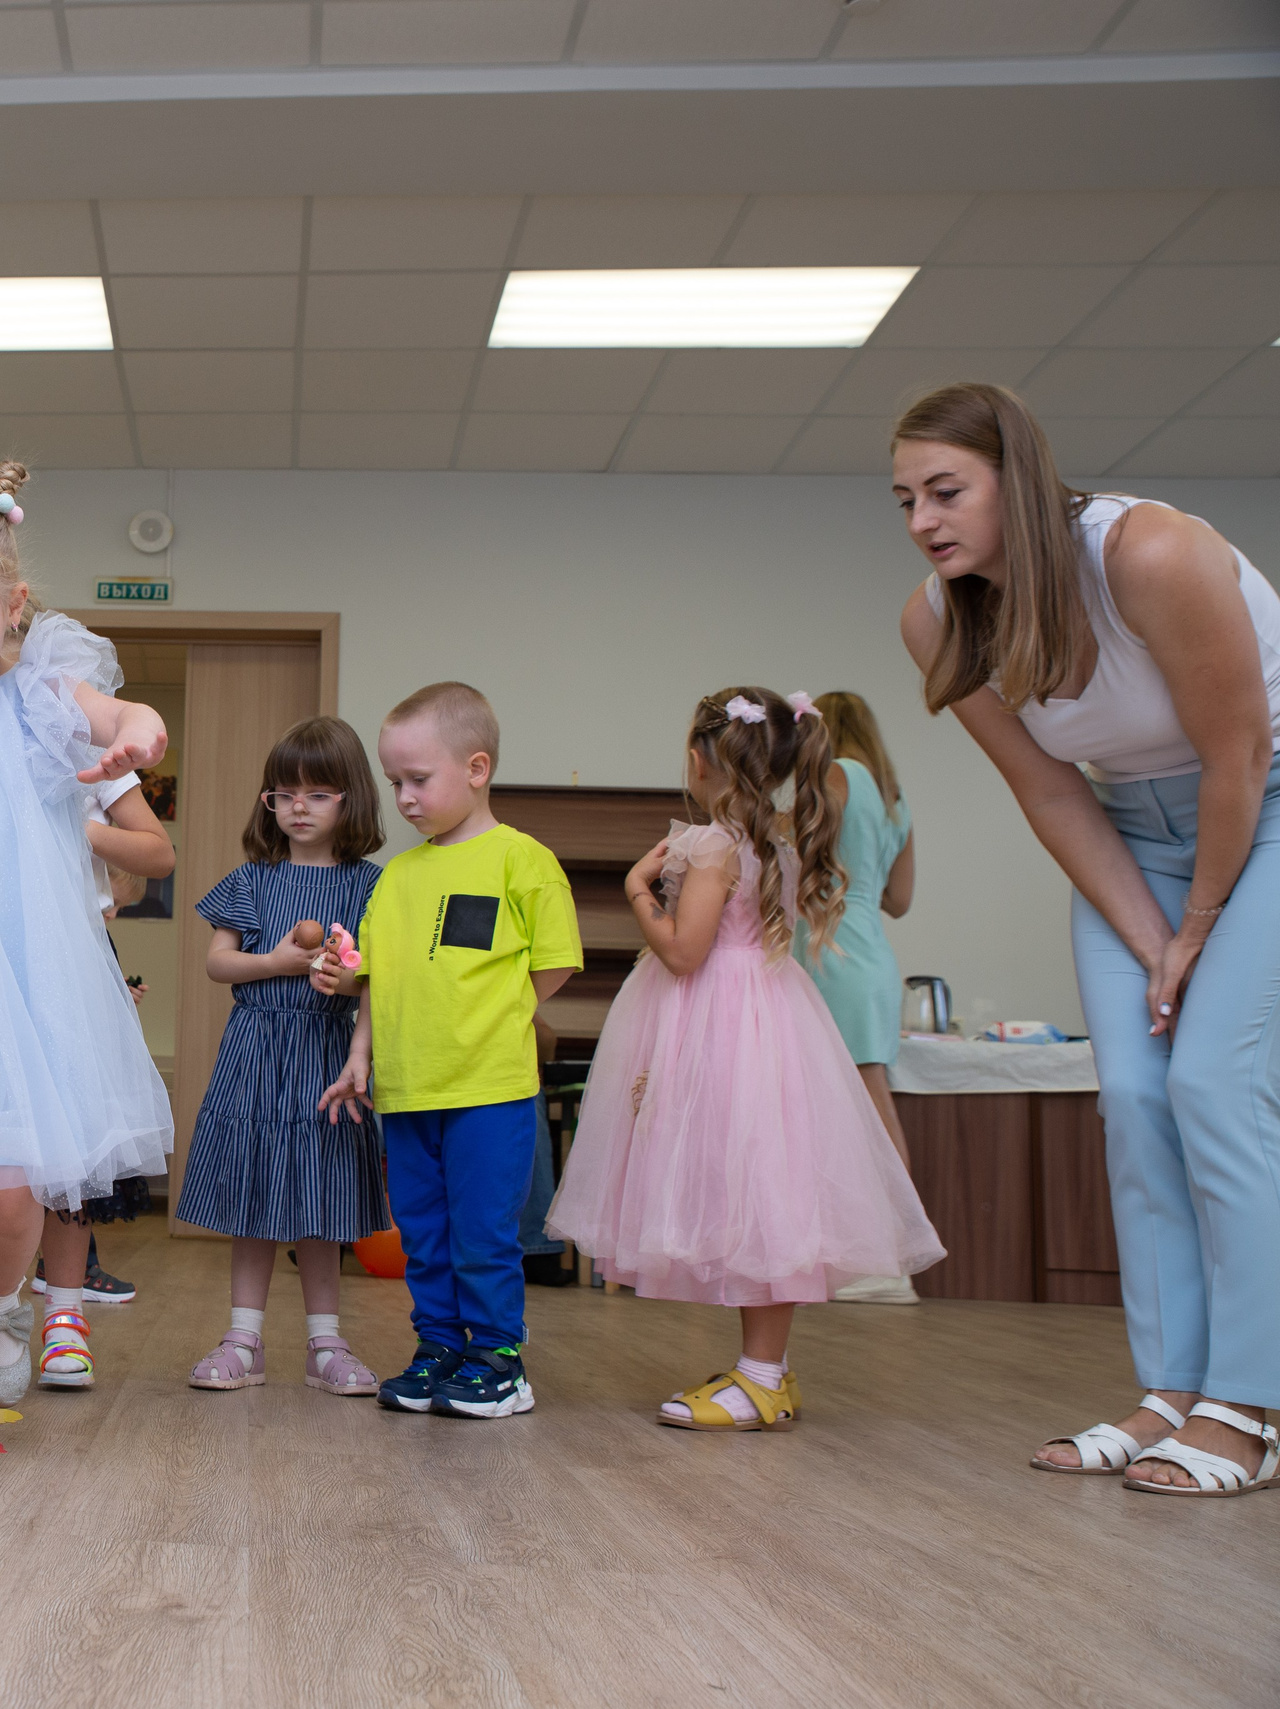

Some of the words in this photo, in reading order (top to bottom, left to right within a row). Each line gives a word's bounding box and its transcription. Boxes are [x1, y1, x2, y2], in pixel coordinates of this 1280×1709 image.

[100, 584, 165, 599] ВЫХОД
[436, 895, 446, 922] Explore
[435, 923, 440, 931] to
[429, 933, 439, 954] World
